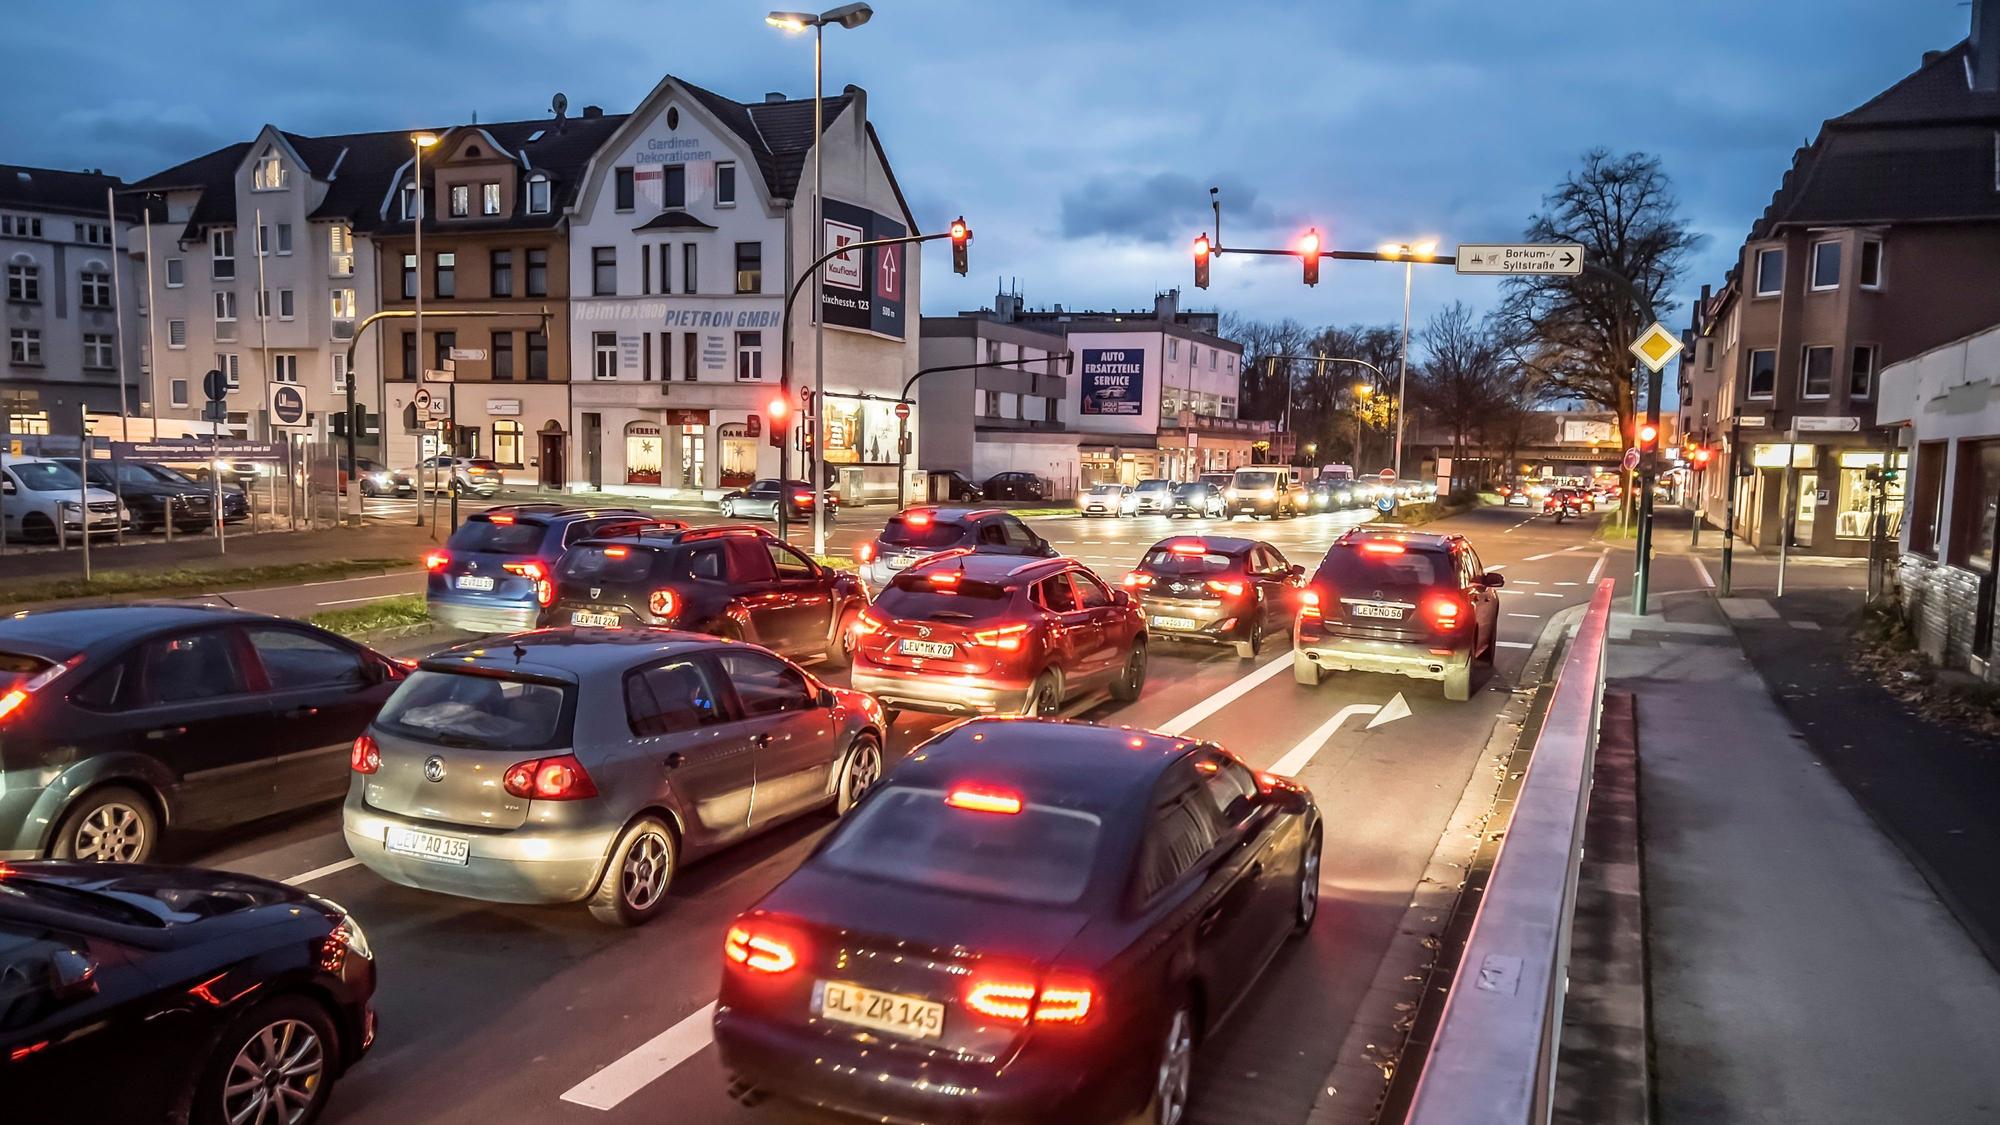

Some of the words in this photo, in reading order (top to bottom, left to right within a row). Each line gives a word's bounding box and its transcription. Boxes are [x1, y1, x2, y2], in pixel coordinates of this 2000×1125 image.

[648, 137, 699, 150] Gardinen
[636, 150, 711, 163] Dekorationen
[1505, 249, 1556, 258] Borkum-/
[828, 263, 857, 277] Kaufland
[1503, 261, 1555, 271] Syltstraße
[822, 294, 856, 307] tixchesstr.
[858, 300, 869, 310] 123
[882, 306, 890, 316] 500
[665, 310, 733, 327] PIETRON
[737, 311, 780, 327] GMBH
[1101, 352, 1125, 361] AUTO
[1085, 364, 1140, 373] ERSATZTEILE
[1094, 376, 1129, 385] SERVICE
[629, 427, 660, 435] HERREN
[1357, 606, 1374, 615] LEV
[1391, 609, 1402, 618] 56
[576, 614, 589, 623] LEV
[904, 641, 920, 652] LEV
[937, 644, 953, 655] 767
[425, 836, 441, 853] AQ
[443, 839, 466, 857] 135
[827, 987, 852, 1012] GL
[866, 994, 893, 1023] ZR
[897, 1003, 939, 1029] 145
